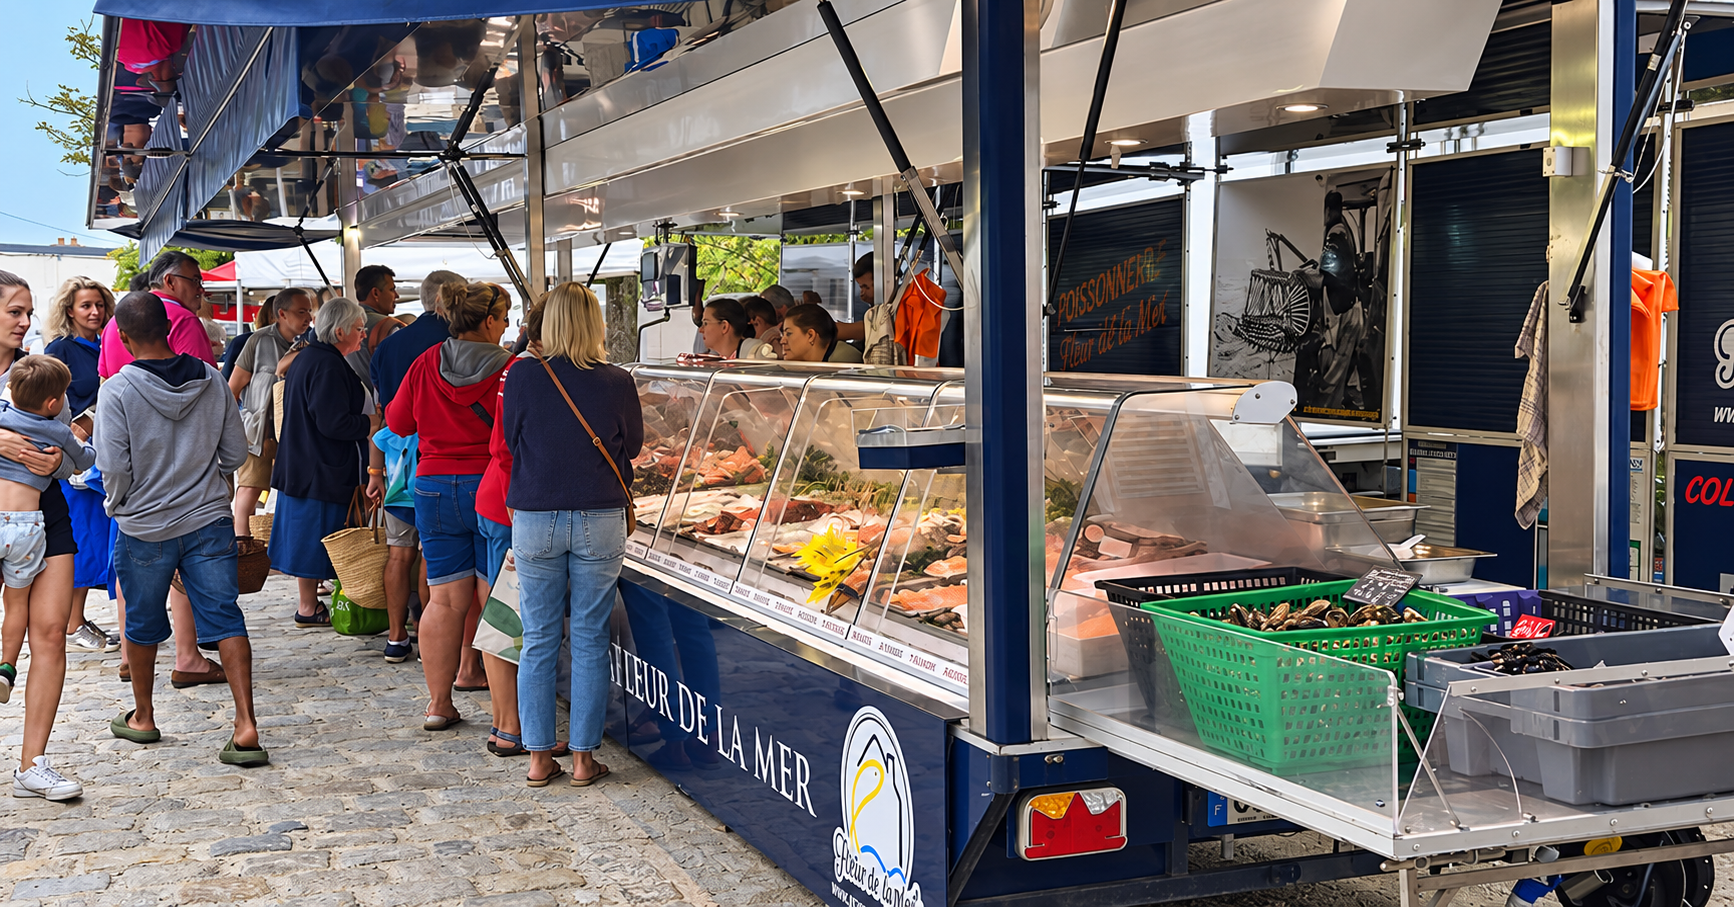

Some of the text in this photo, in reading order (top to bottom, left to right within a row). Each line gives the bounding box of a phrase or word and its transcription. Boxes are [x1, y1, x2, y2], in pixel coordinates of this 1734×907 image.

[1060, 332, 1095, 371] Fleur
[1685, 475, 1734, 507] COL
[611, 642, 675, 722] FLEUR
[676, 680, 709, 745] DE
[714, 704, 748, 772] LA
[753, 726, 818, 818] MER
[1214, 804, 1222, 816] F
[867, 867, 880, 895] de
[882, 874, 893, 905] la
